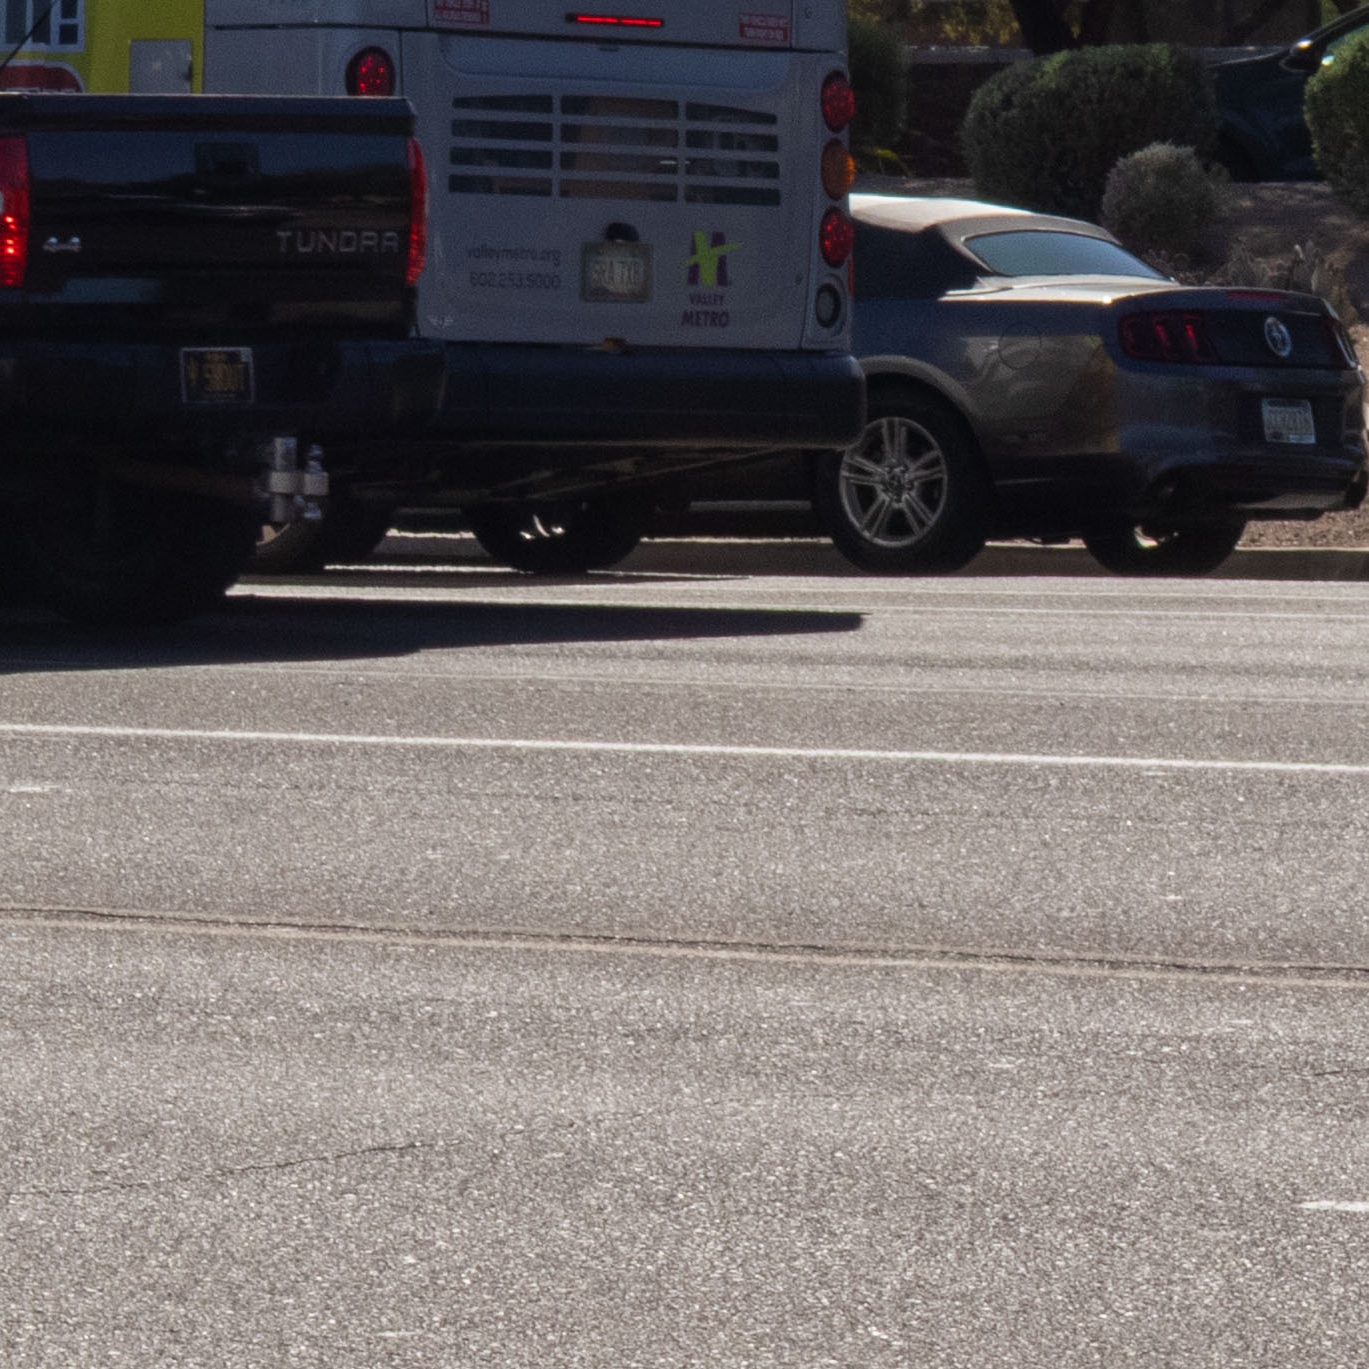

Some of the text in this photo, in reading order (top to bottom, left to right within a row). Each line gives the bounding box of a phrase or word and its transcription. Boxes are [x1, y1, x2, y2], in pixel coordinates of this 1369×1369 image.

[276, 230, 399, 255] TUNDRA
[689, 293, 725, 306] VALLEY
[681, 310, 730, 329] METRO
